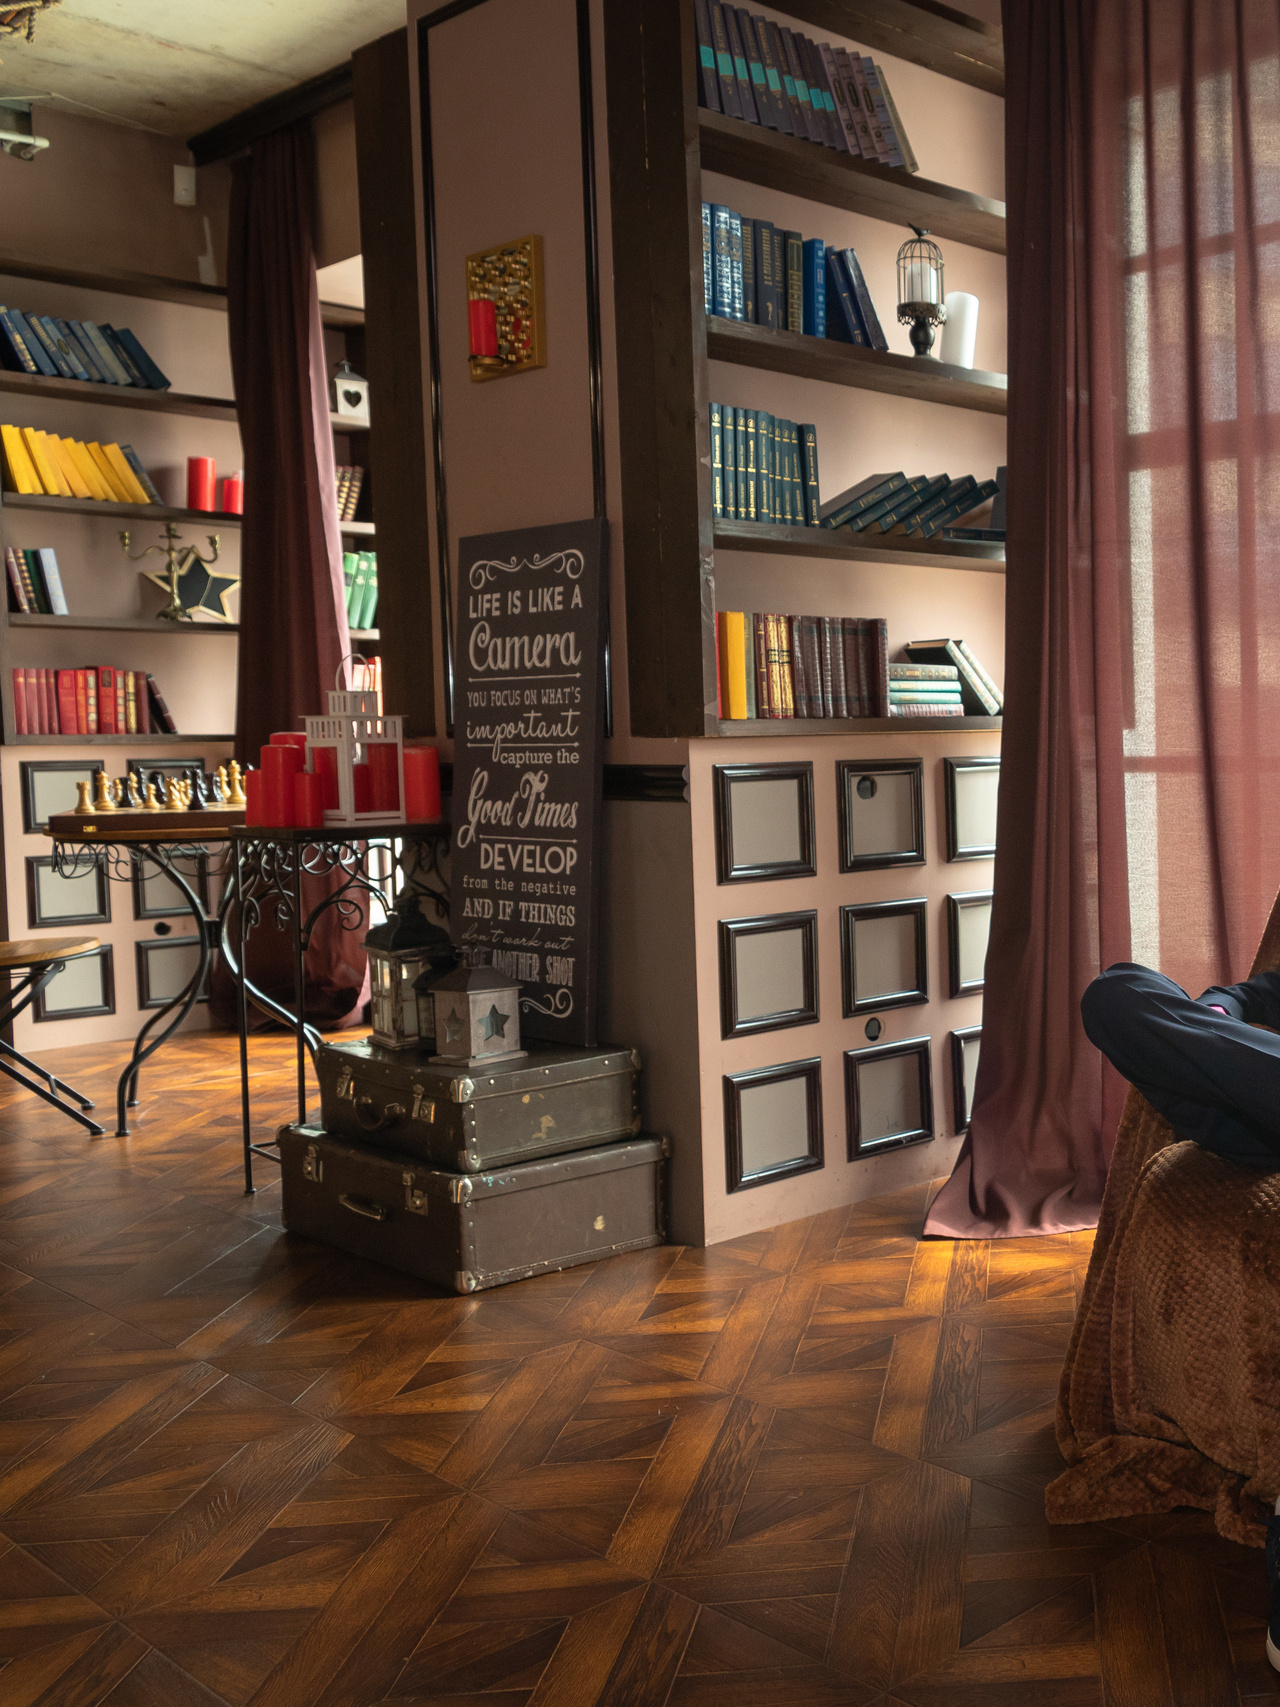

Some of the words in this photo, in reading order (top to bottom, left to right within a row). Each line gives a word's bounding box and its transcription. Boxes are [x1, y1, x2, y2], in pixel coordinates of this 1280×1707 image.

[469, 593, 500, 618] LIFE
[508, 590, 521, 614] IS
[528, 586, 564, 613] LIKE
[571, 584, 582, 608] A
[469, 621, 582, 672] Camera
[467, 691, 487, 707] YOU
[490, 690, 521, 706] FOCUS
[524, 688, 537, 705] ON
[541, 686, 581, 704] WHAT'S
[466, 708, 580, 762] important
[500, 751, 553, 768] capture
[557, 749, 579, 764] the
[457, 767, 519, 848] Good
[517, 770, 578, 829] Times
[480, 843, 577, 874] DEVELOP
[462, 875, 488, 889] from
[494, 877, 514, 891] the
[520, 880, 577, 897] negative
[462, 897, 493, 918] AND
[498, 899, 513, 921] IF
[518, 902, 576, 927] THINGS
[461, 920, 503, 943] don't
[502, 927, 542, 947] work
[544, 935, 574, 951] out
[492, 949, 540, 981] ANOTHER
[545, 955, 576, 987] SHOT
